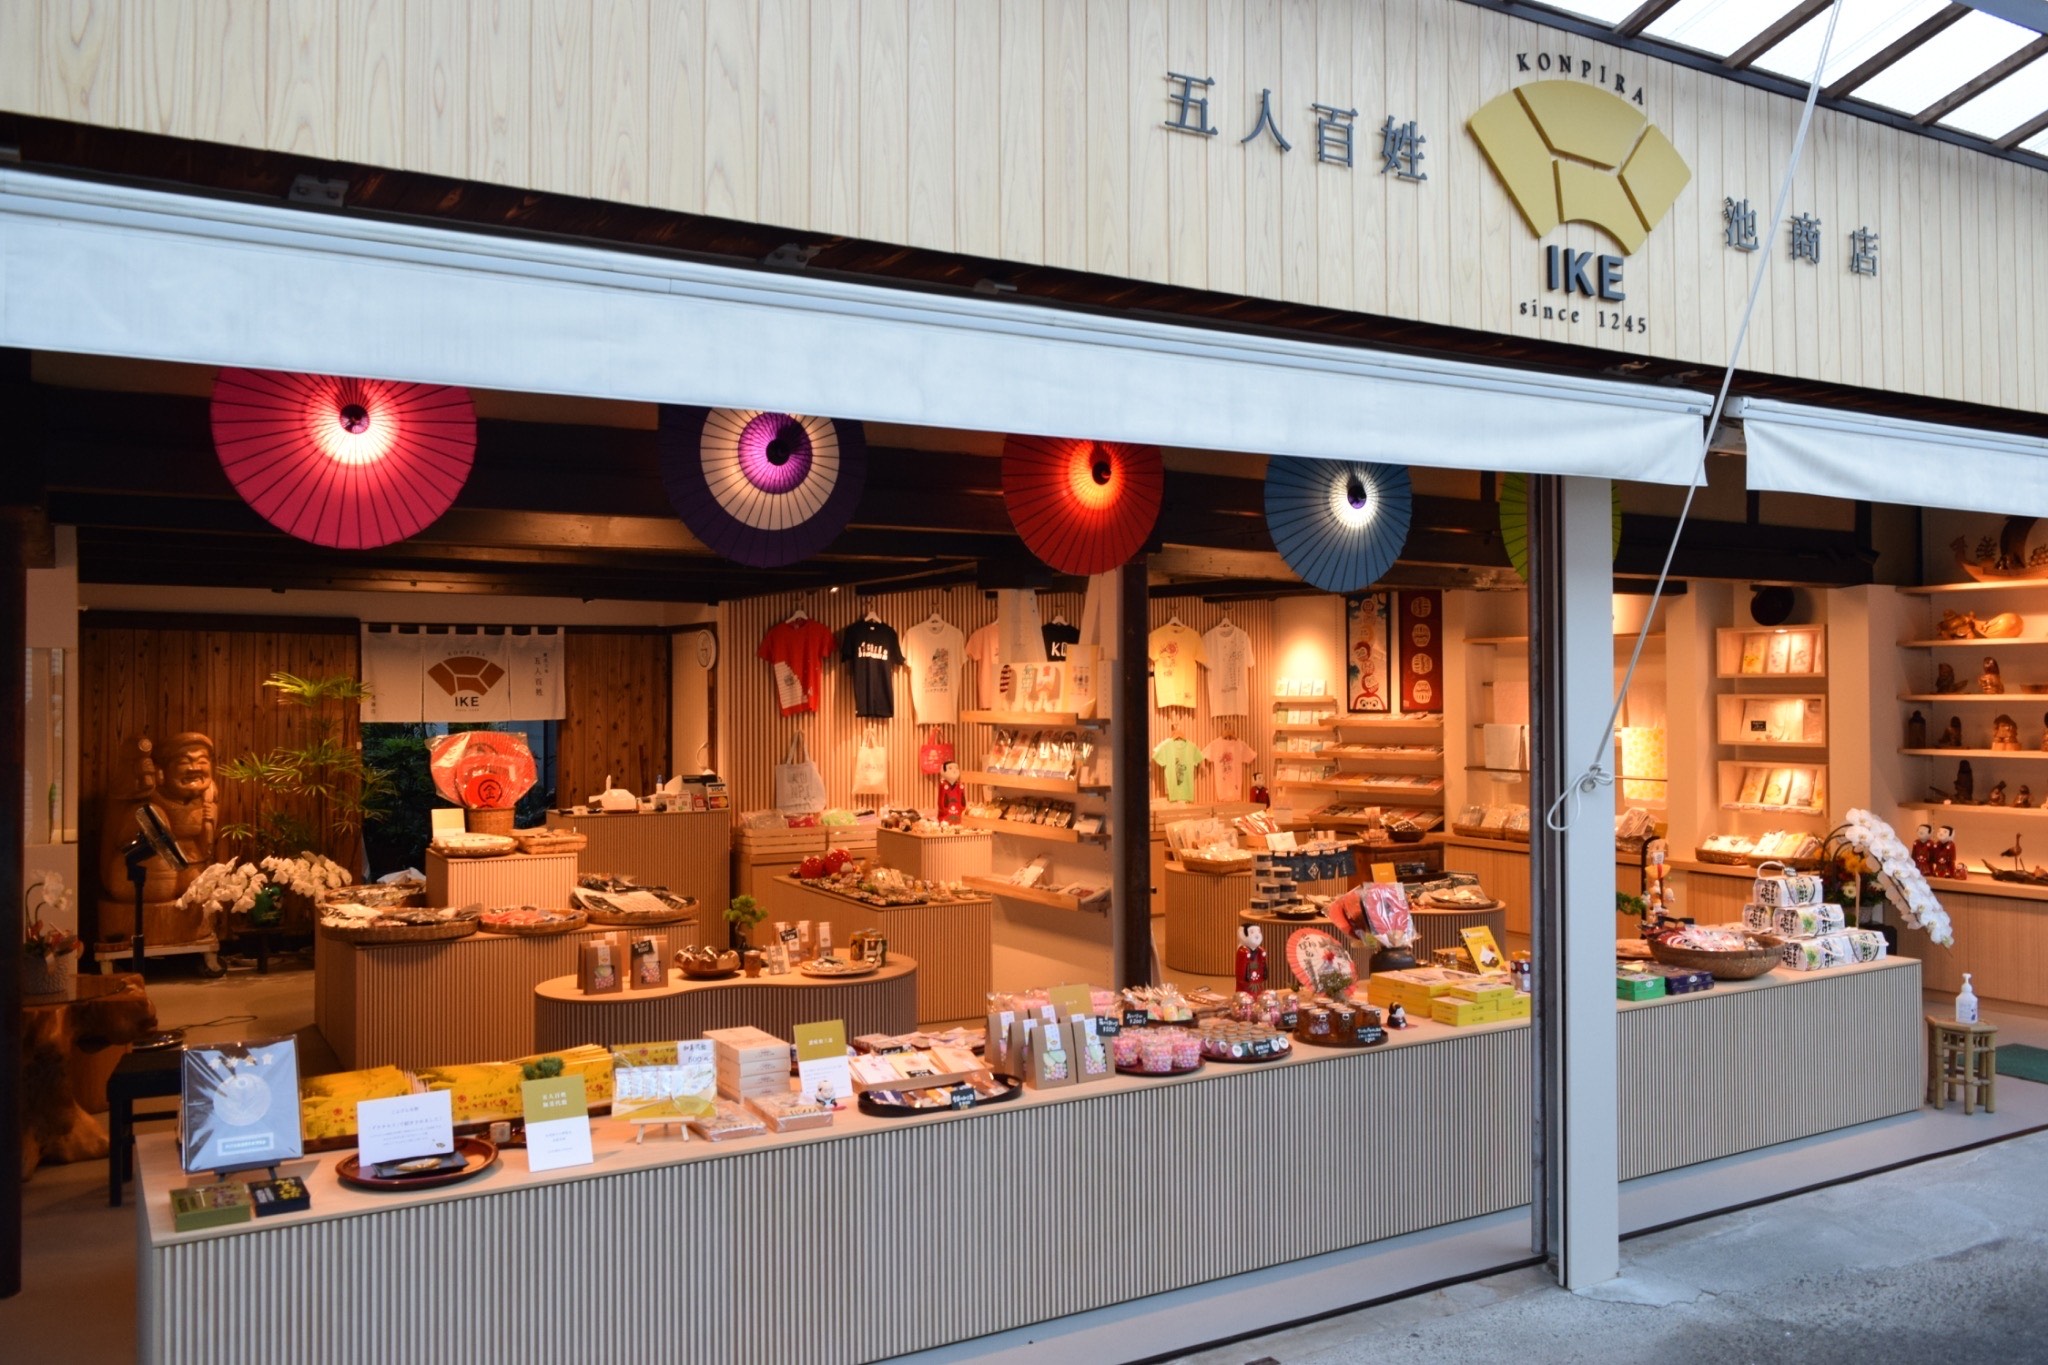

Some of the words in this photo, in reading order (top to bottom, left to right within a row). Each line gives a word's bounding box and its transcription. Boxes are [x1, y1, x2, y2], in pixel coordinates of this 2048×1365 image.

[1516, 52, 1644, 105] KONPIRA
[1164, 71, 1428, 181] 五人百姓
[1722, 196, 1879, 277] 池商店
[1546, 244, 1626, 301] IKE
[1519, 299, 1580, 323] since
[1598, 310, 1647, 334] 1245
[455, 696, 479, 707] IKE
